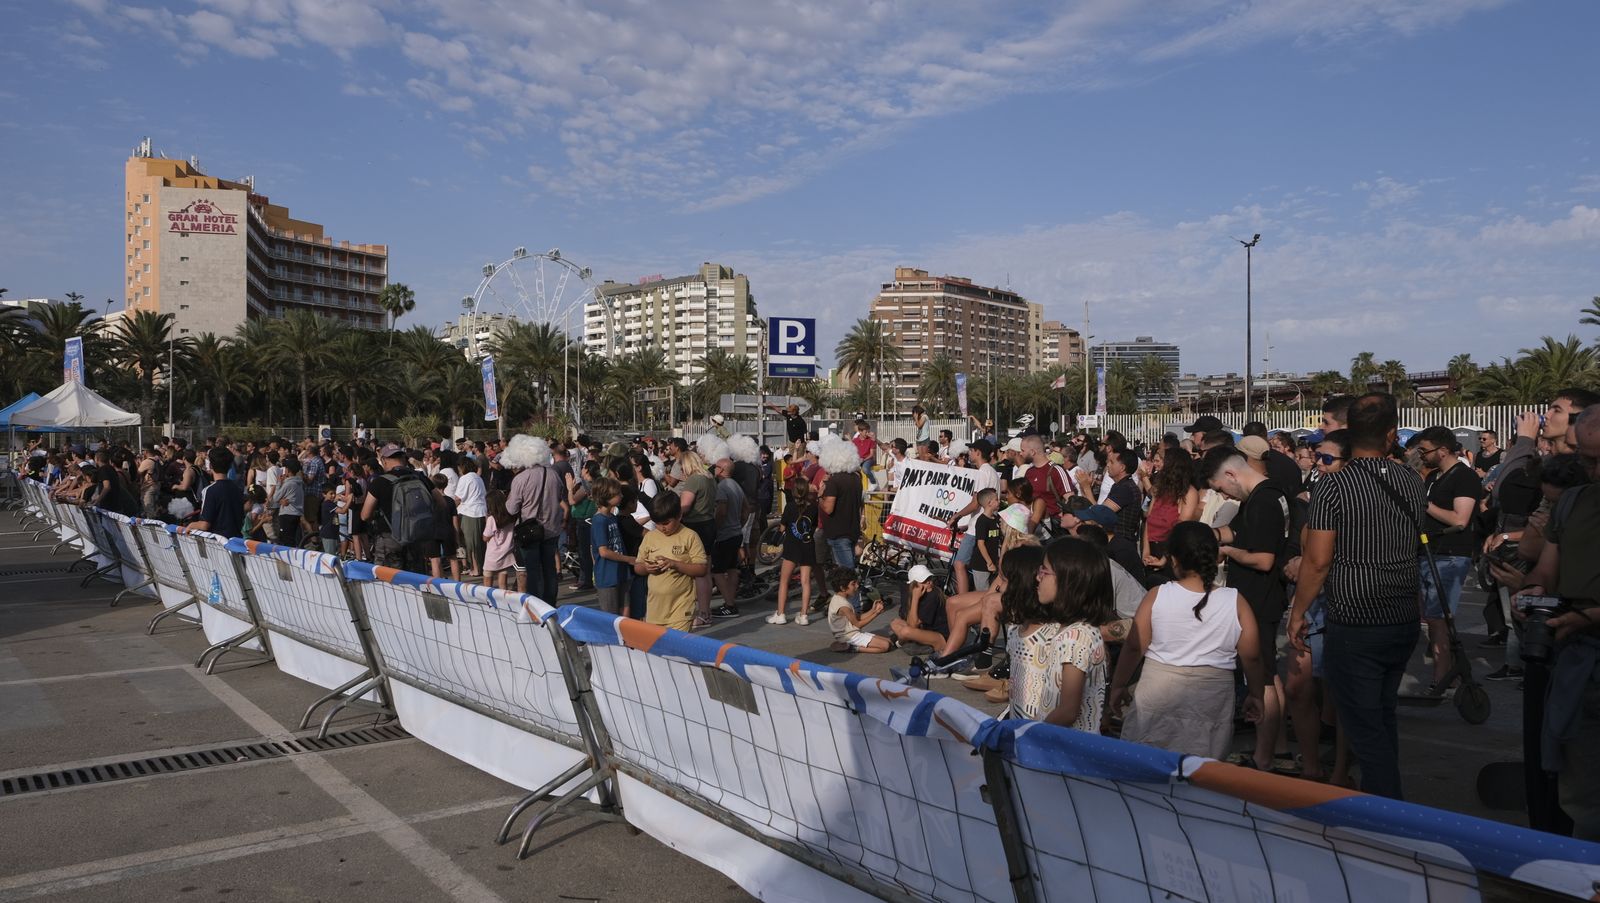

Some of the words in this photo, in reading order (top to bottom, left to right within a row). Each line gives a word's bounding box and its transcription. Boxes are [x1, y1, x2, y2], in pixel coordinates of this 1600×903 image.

[168, 213, 198, 222] GRAN
[204, 215, 238, 224] HOTEL
[170, 222, 235, 232] ALMERIA
[779, 320, 806, 353] P
[900, 467, 927, 490] BMX
[925, 472, 951, 486] PARK
[951, 473, 975, 496] OLÍM
[918, 503, 930, 515] EN
[917, 529, 928, 540] DE
